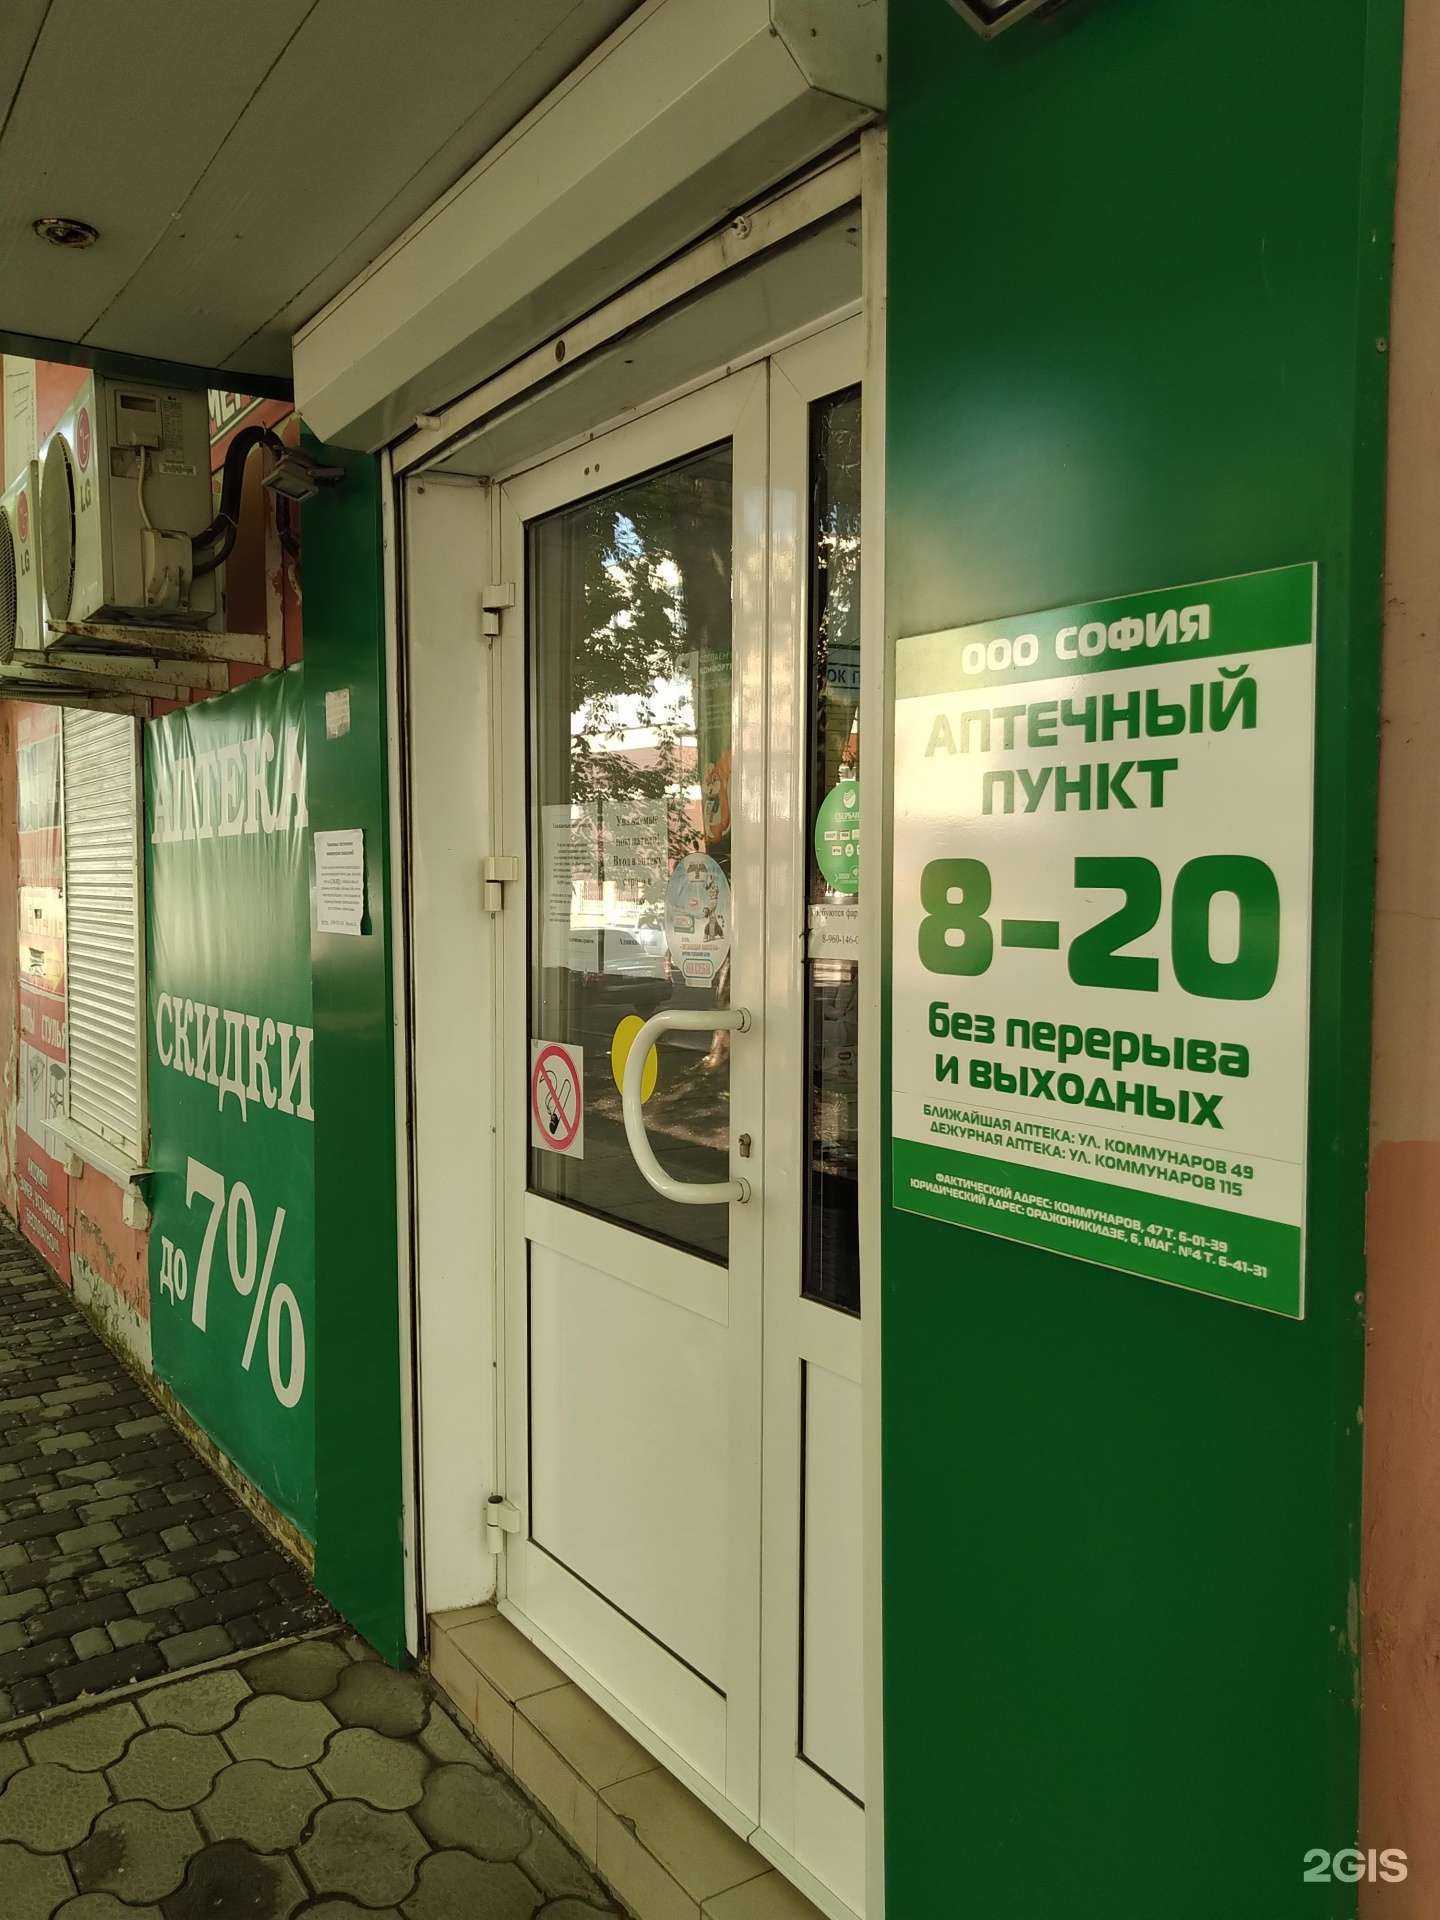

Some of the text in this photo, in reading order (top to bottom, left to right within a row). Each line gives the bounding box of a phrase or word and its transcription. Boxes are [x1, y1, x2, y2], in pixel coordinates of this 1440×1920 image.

[80, 478, 92, 513] LG
[20, 549, 30, 576] LG
[961, 604, 1211, 675] ООО СОФИЯ
[925, 664, 1257, 758] АПТЕЧНЫЙ
[151, 727, 308, 845] АПТЕКА
[982, 757, 1178, 815] ПУНКТ
[918, 855, 1280, 1001] 8-20
[156, 991, 315, 1122] СКИДКИ
[929, 1000, 1250, 1078] без перерыва
[923, 1103, 1254, 1180] БЛИЖАЙШАЯ АПТЕКА: УЛ. КОММУНАРОВ 49
[930, 1120, 1243, 1197] ДЕЖУРНАЯ АПТЕКА: УЛ. КОММУНАРОВ 115
[910, 1177, 987, 1205] ЮРИДИЧЕСКИЙ
[987, 1198, 1026, 1215] АДРЕС:
[1026, 1206, 1128, 1242] ОРДЖОНИКИДЗЕ,
[1130, 1232, 1142, 1247] 6,
[1144, 1236, 1176, 1254] МАГ.
[1218, 1255, 1268, 1279] 6-41-31
[935, 1172, 1012, 1200] ФАКТИЧЕСКИЙ
[1013, 1191, 1053, 1209] АДРЕС:
[1053, 1200, 1144, 1233] КОММУНАРОВ,
[1178, 1231, 1228, 1253] 6-01-39
[185, 1156, 306, 1408] 7%
